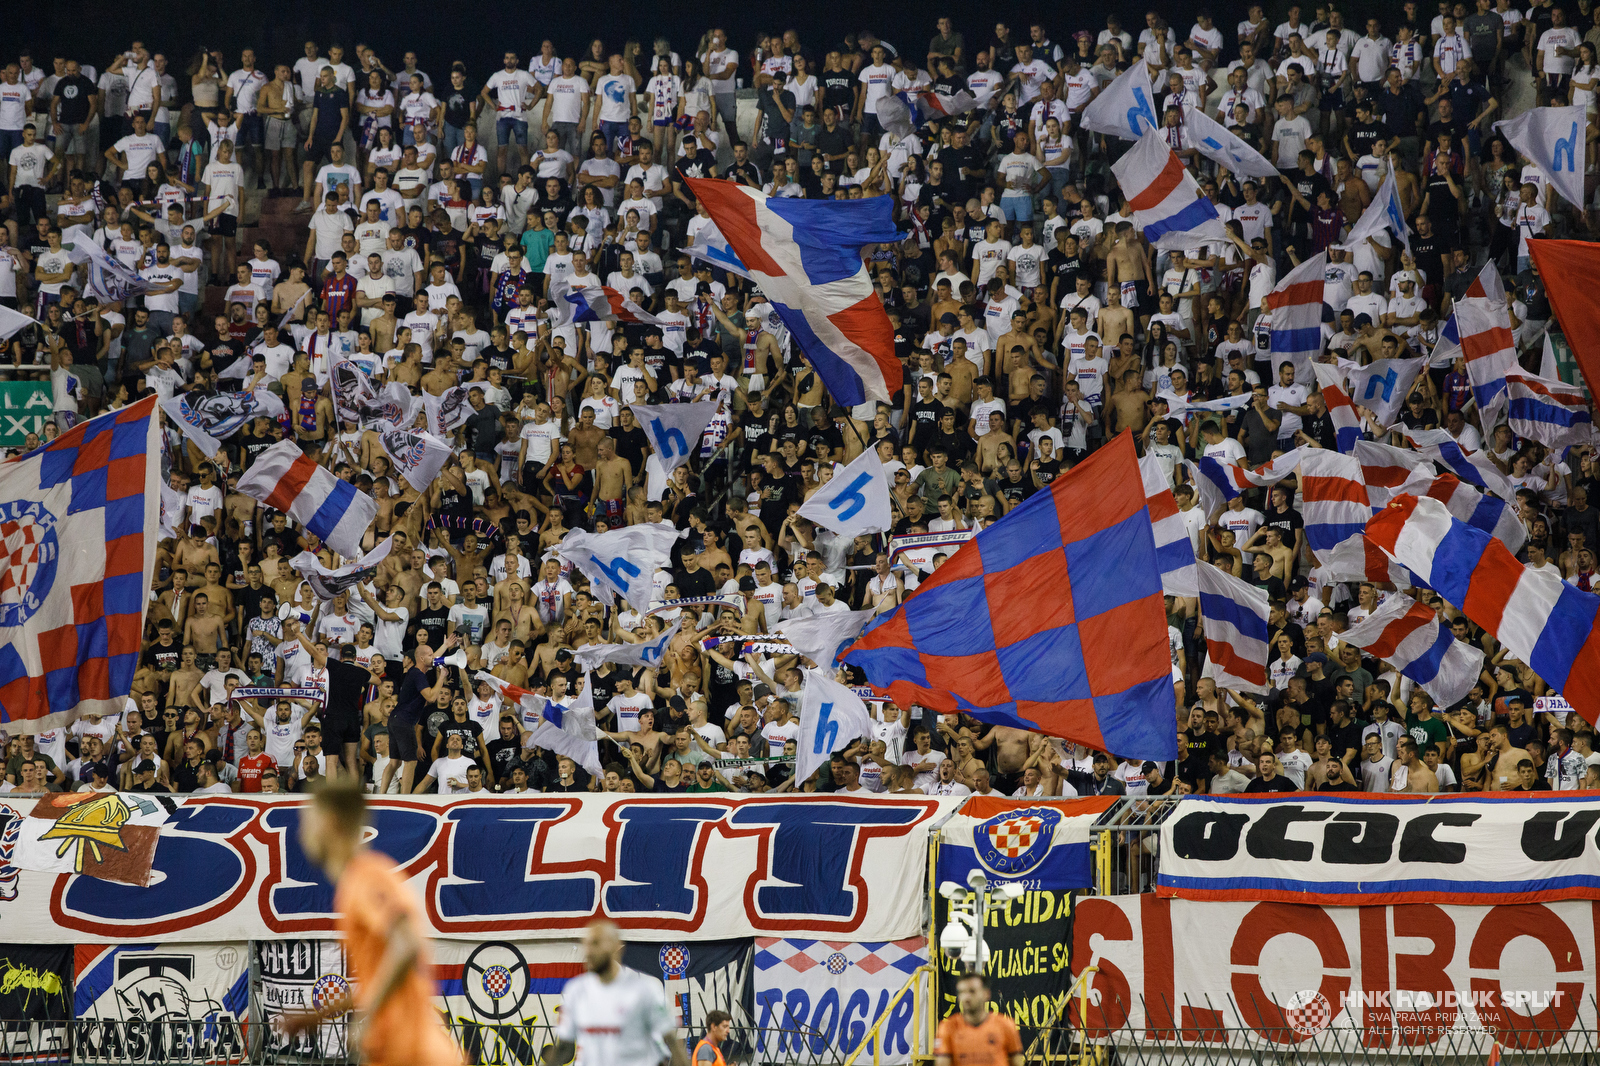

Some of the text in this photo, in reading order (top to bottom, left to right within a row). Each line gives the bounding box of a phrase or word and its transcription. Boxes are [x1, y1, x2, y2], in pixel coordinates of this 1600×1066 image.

[903, 534, 939, 544] HAJDUK
[290, 689, 324, 698] SPLIT
[54, 797, 938, 938] SPLIT
[985, 850, 1036, 872] SPLIT
[219, 951, 235, 966] VII
[485, 966, 510, 977] HAJDUK
[1069, 893, 1600, 1050] SLOBO
[315, 976, 348, 990] HAJDUK
[756, 987, 914, 1056] TROGIR
